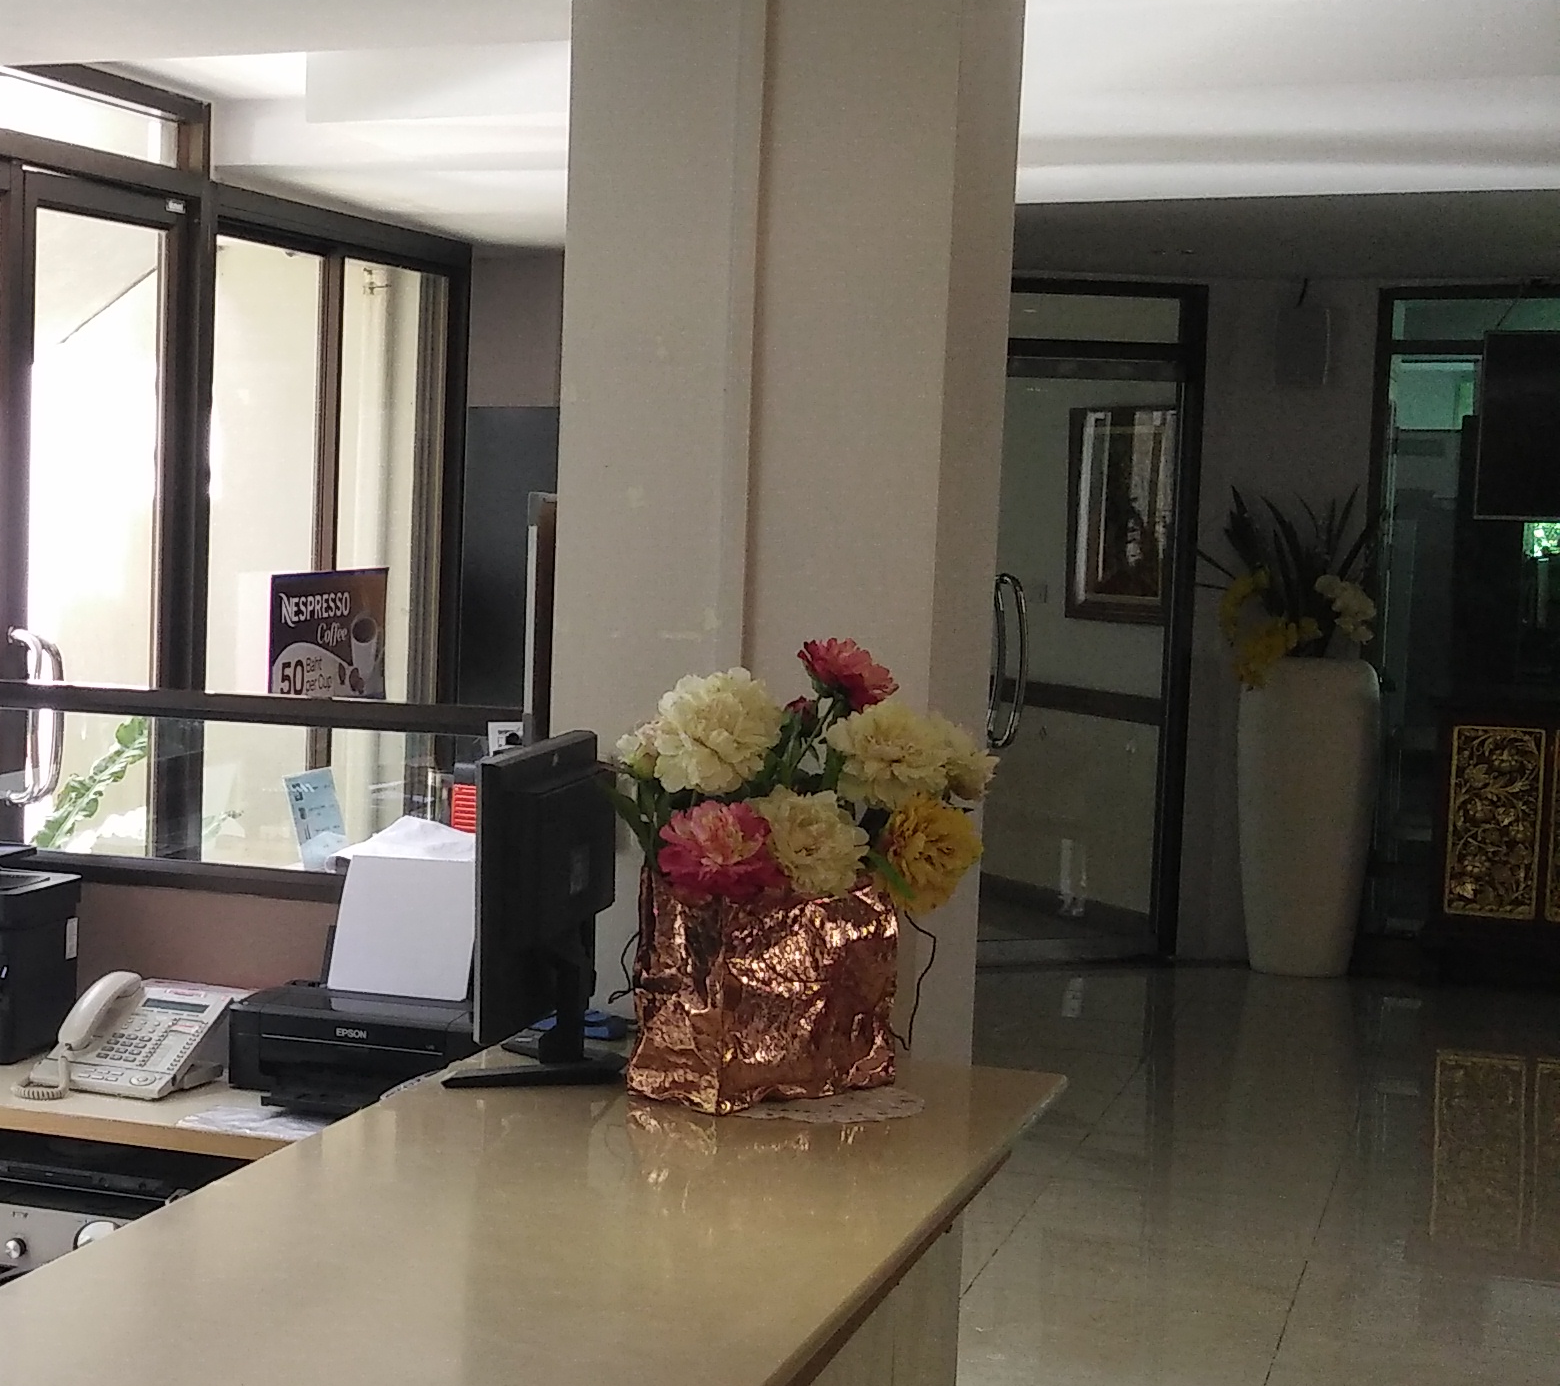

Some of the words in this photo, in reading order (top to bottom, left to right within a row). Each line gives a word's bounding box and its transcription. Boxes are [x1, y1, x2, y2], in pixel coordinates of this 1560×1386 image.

[279, 592, 351, 628] NESPRESSO
[317, 621, 348, 647] Coffee
[280, 659, 305, 695] 50
[305, 656, 323, 674] Baht
[305, 678, 317, 693] per
[317, 672, 332, 692] Cup
[336, 1027, 367, 1039] EPSON
